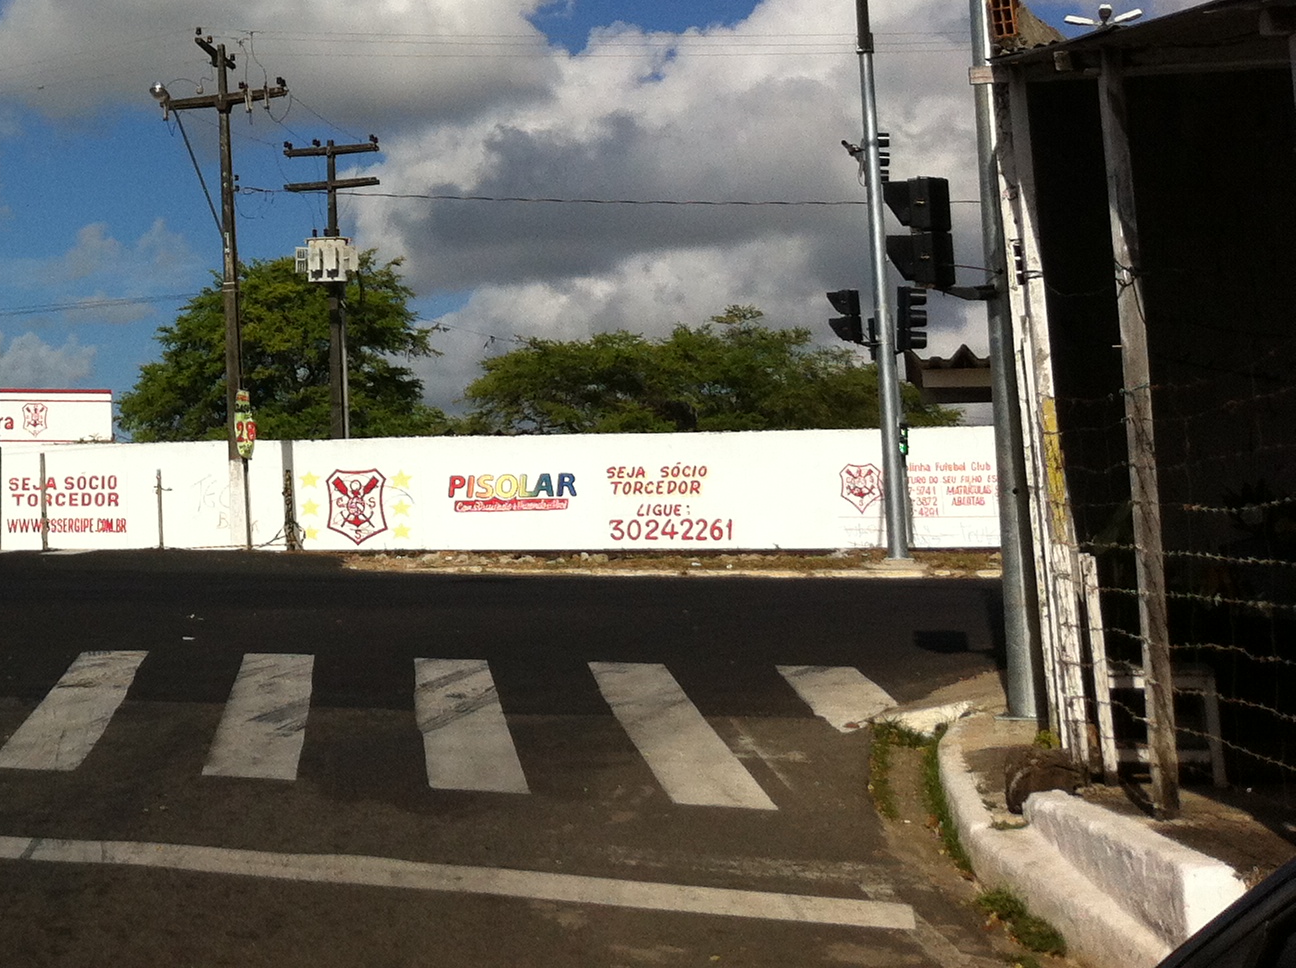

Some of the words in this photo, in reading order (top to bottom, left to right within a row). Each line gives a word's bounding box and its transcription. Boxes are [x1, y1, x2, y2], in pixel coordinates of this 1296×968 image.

[606, 466, 646, 479] SEJA
[660, 462, 707, 478] SÓCIO
[971, 461, 991, 471] Club
[9, 477, 57, 491] SEJA
[448, 472, 577, 499] PISOLAR
[610, 480, 701, 495] TORCEDOR
[929, 476, 938, 484] DO
[942, 476, 956, 484] SEU
[609, 518, 733, 541] 30242261
